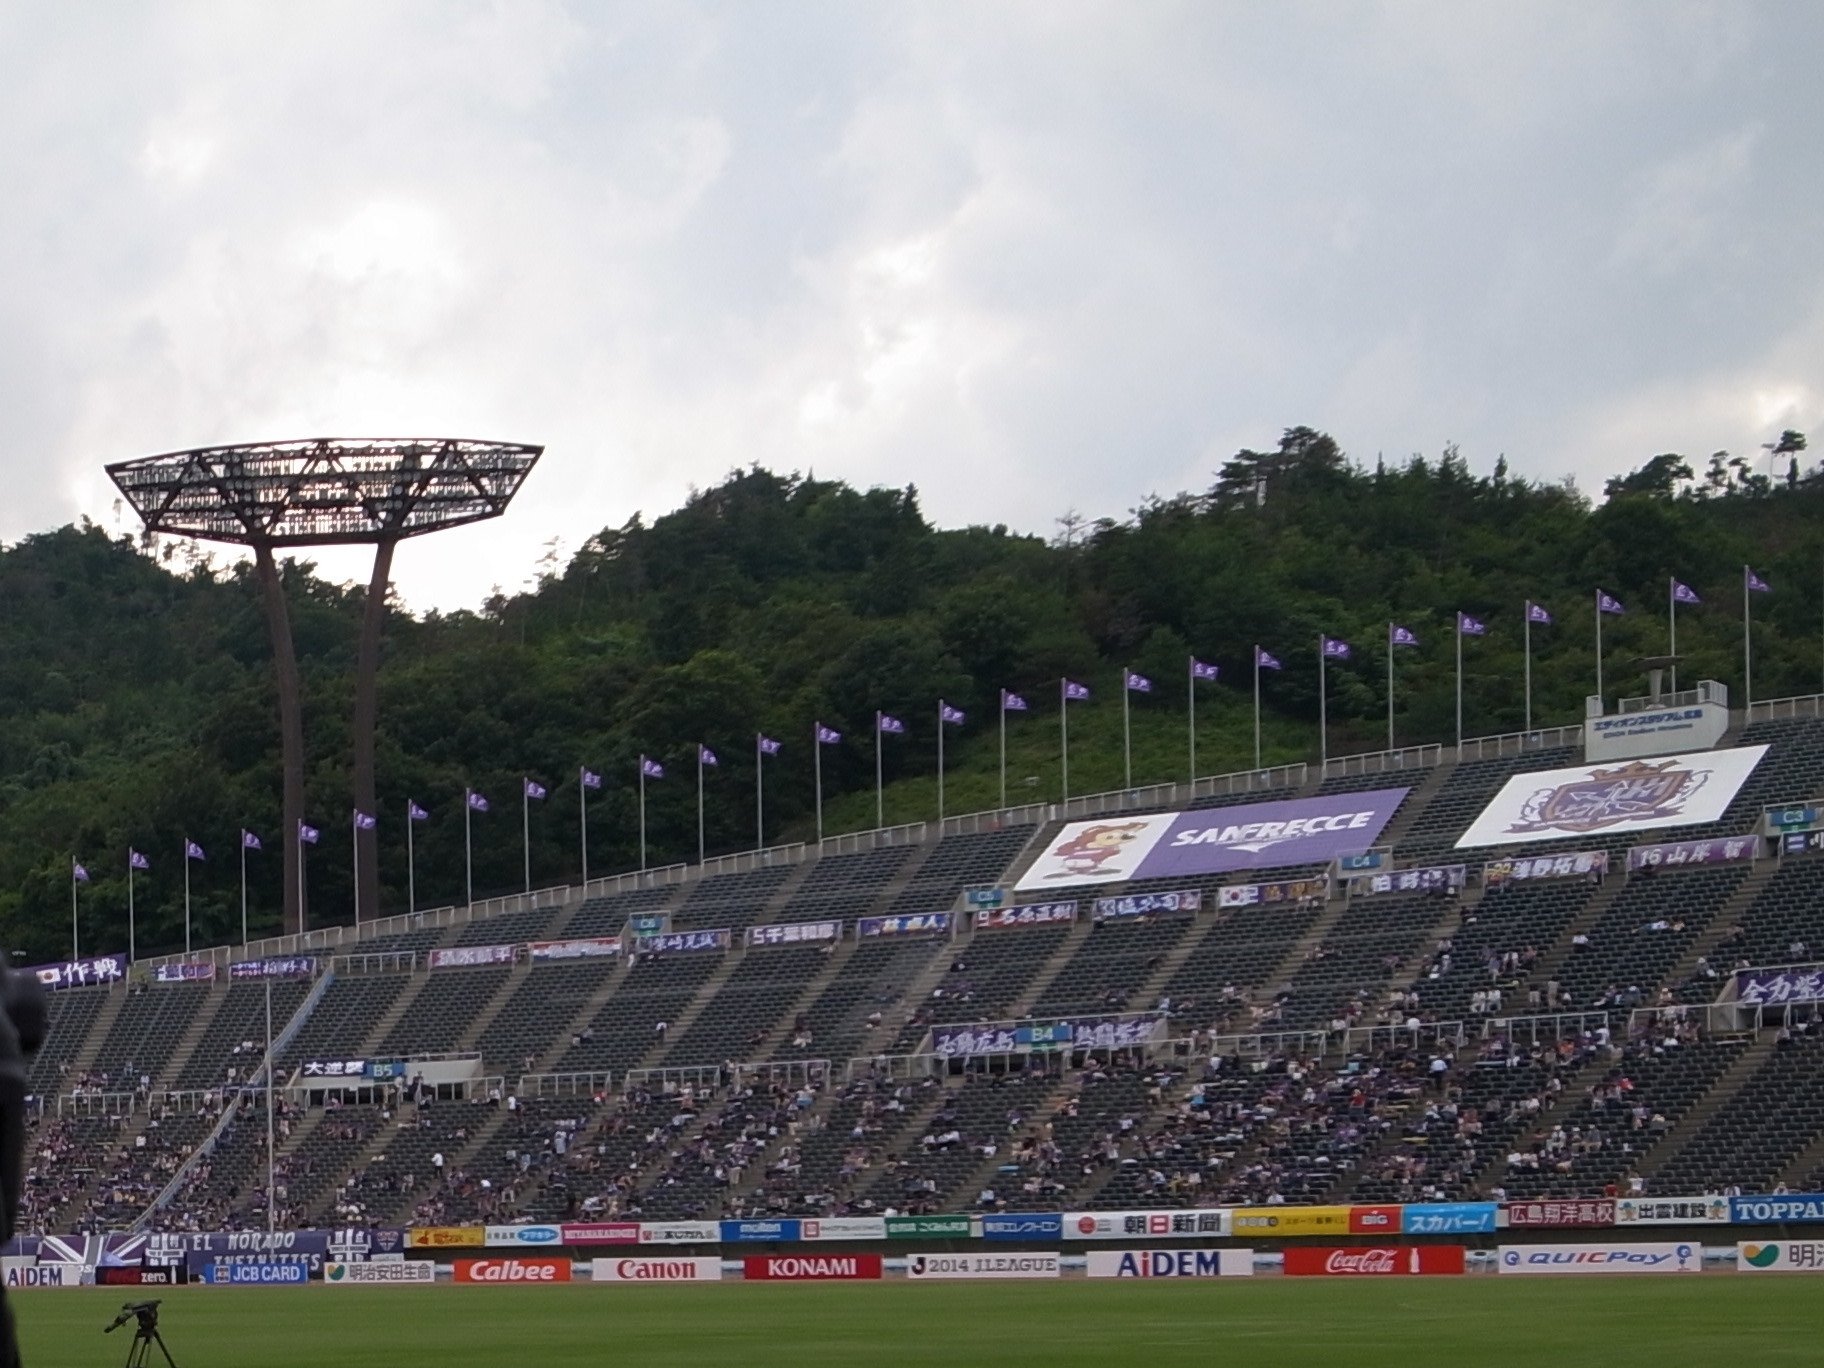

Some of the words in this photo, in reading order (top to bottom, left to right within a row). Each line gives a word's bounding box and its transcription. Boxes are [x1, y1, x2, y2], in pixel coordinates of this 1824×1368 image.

[1783, 810, 1804, 823] C3
[1170, 810, 1375, 846] SANFRECCE
[1352, 856, 1371, 867] C4
[1640, 849, 1663, 865] 16
[1031, 1028, 1054, 1041] B4
[1737, 1201, 1824, 1220] TOPPA
[1124, 1213, 1221, 1234] 朝日新聞
[768, 1258, 857, 1276] KONAMI
[929, 1259, 969, 1272] 2014
[1528, 1251, 1672, 1266] QUICPay
[233, 1266, 260, 1281] JCB
[262, 1266, 301, 1281] CARD
[349, 1263, 431, 1281] 明治安田生命
[469, 1260, 557, 1281] Calbee
[617, 1260, 696, 1279] Canon
